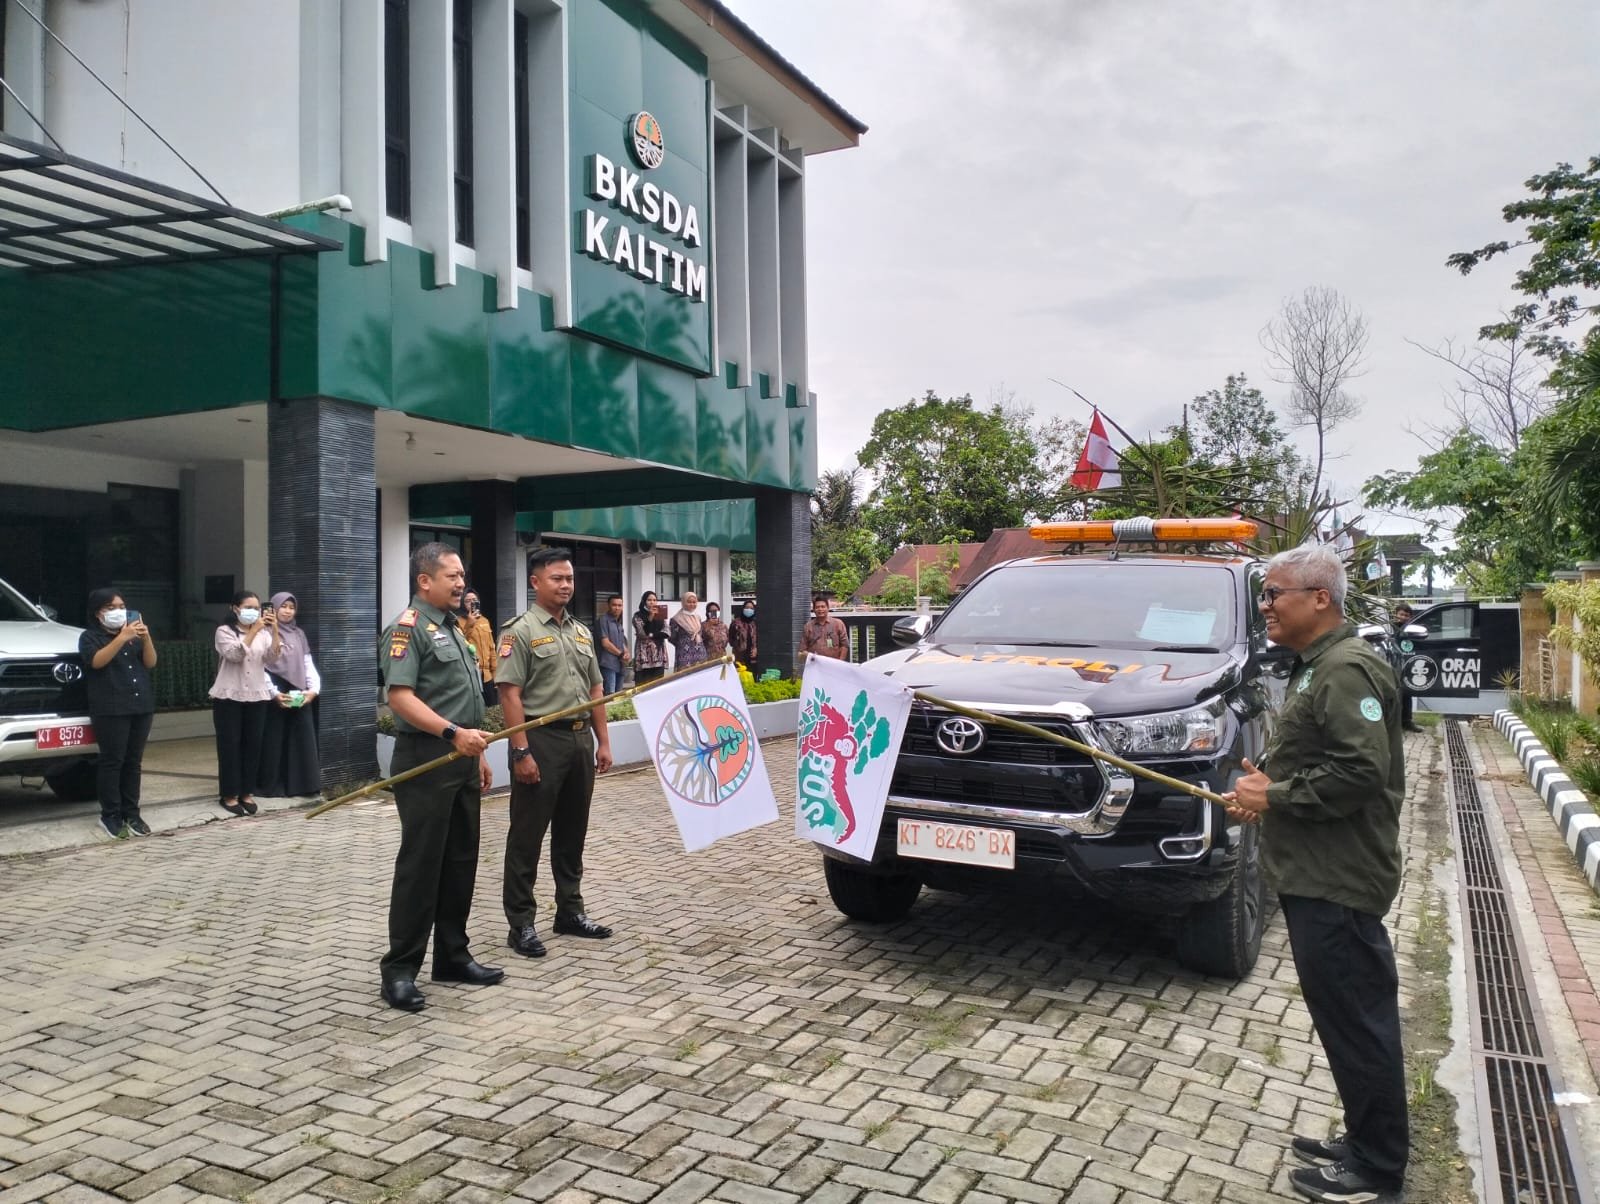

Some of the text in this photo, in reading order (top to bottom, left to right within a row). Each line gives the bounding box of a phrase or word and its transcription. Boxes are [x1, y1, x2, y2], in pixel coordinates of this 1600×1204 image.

[595, 153, 701, 247] BKSDA
[586, 208, 706, 303] KALTIM
[38, 729, 51, 743] KT
[59, 726, 84, 740] 8573
[900, 823, 1011, 856] KT 8246 BX
